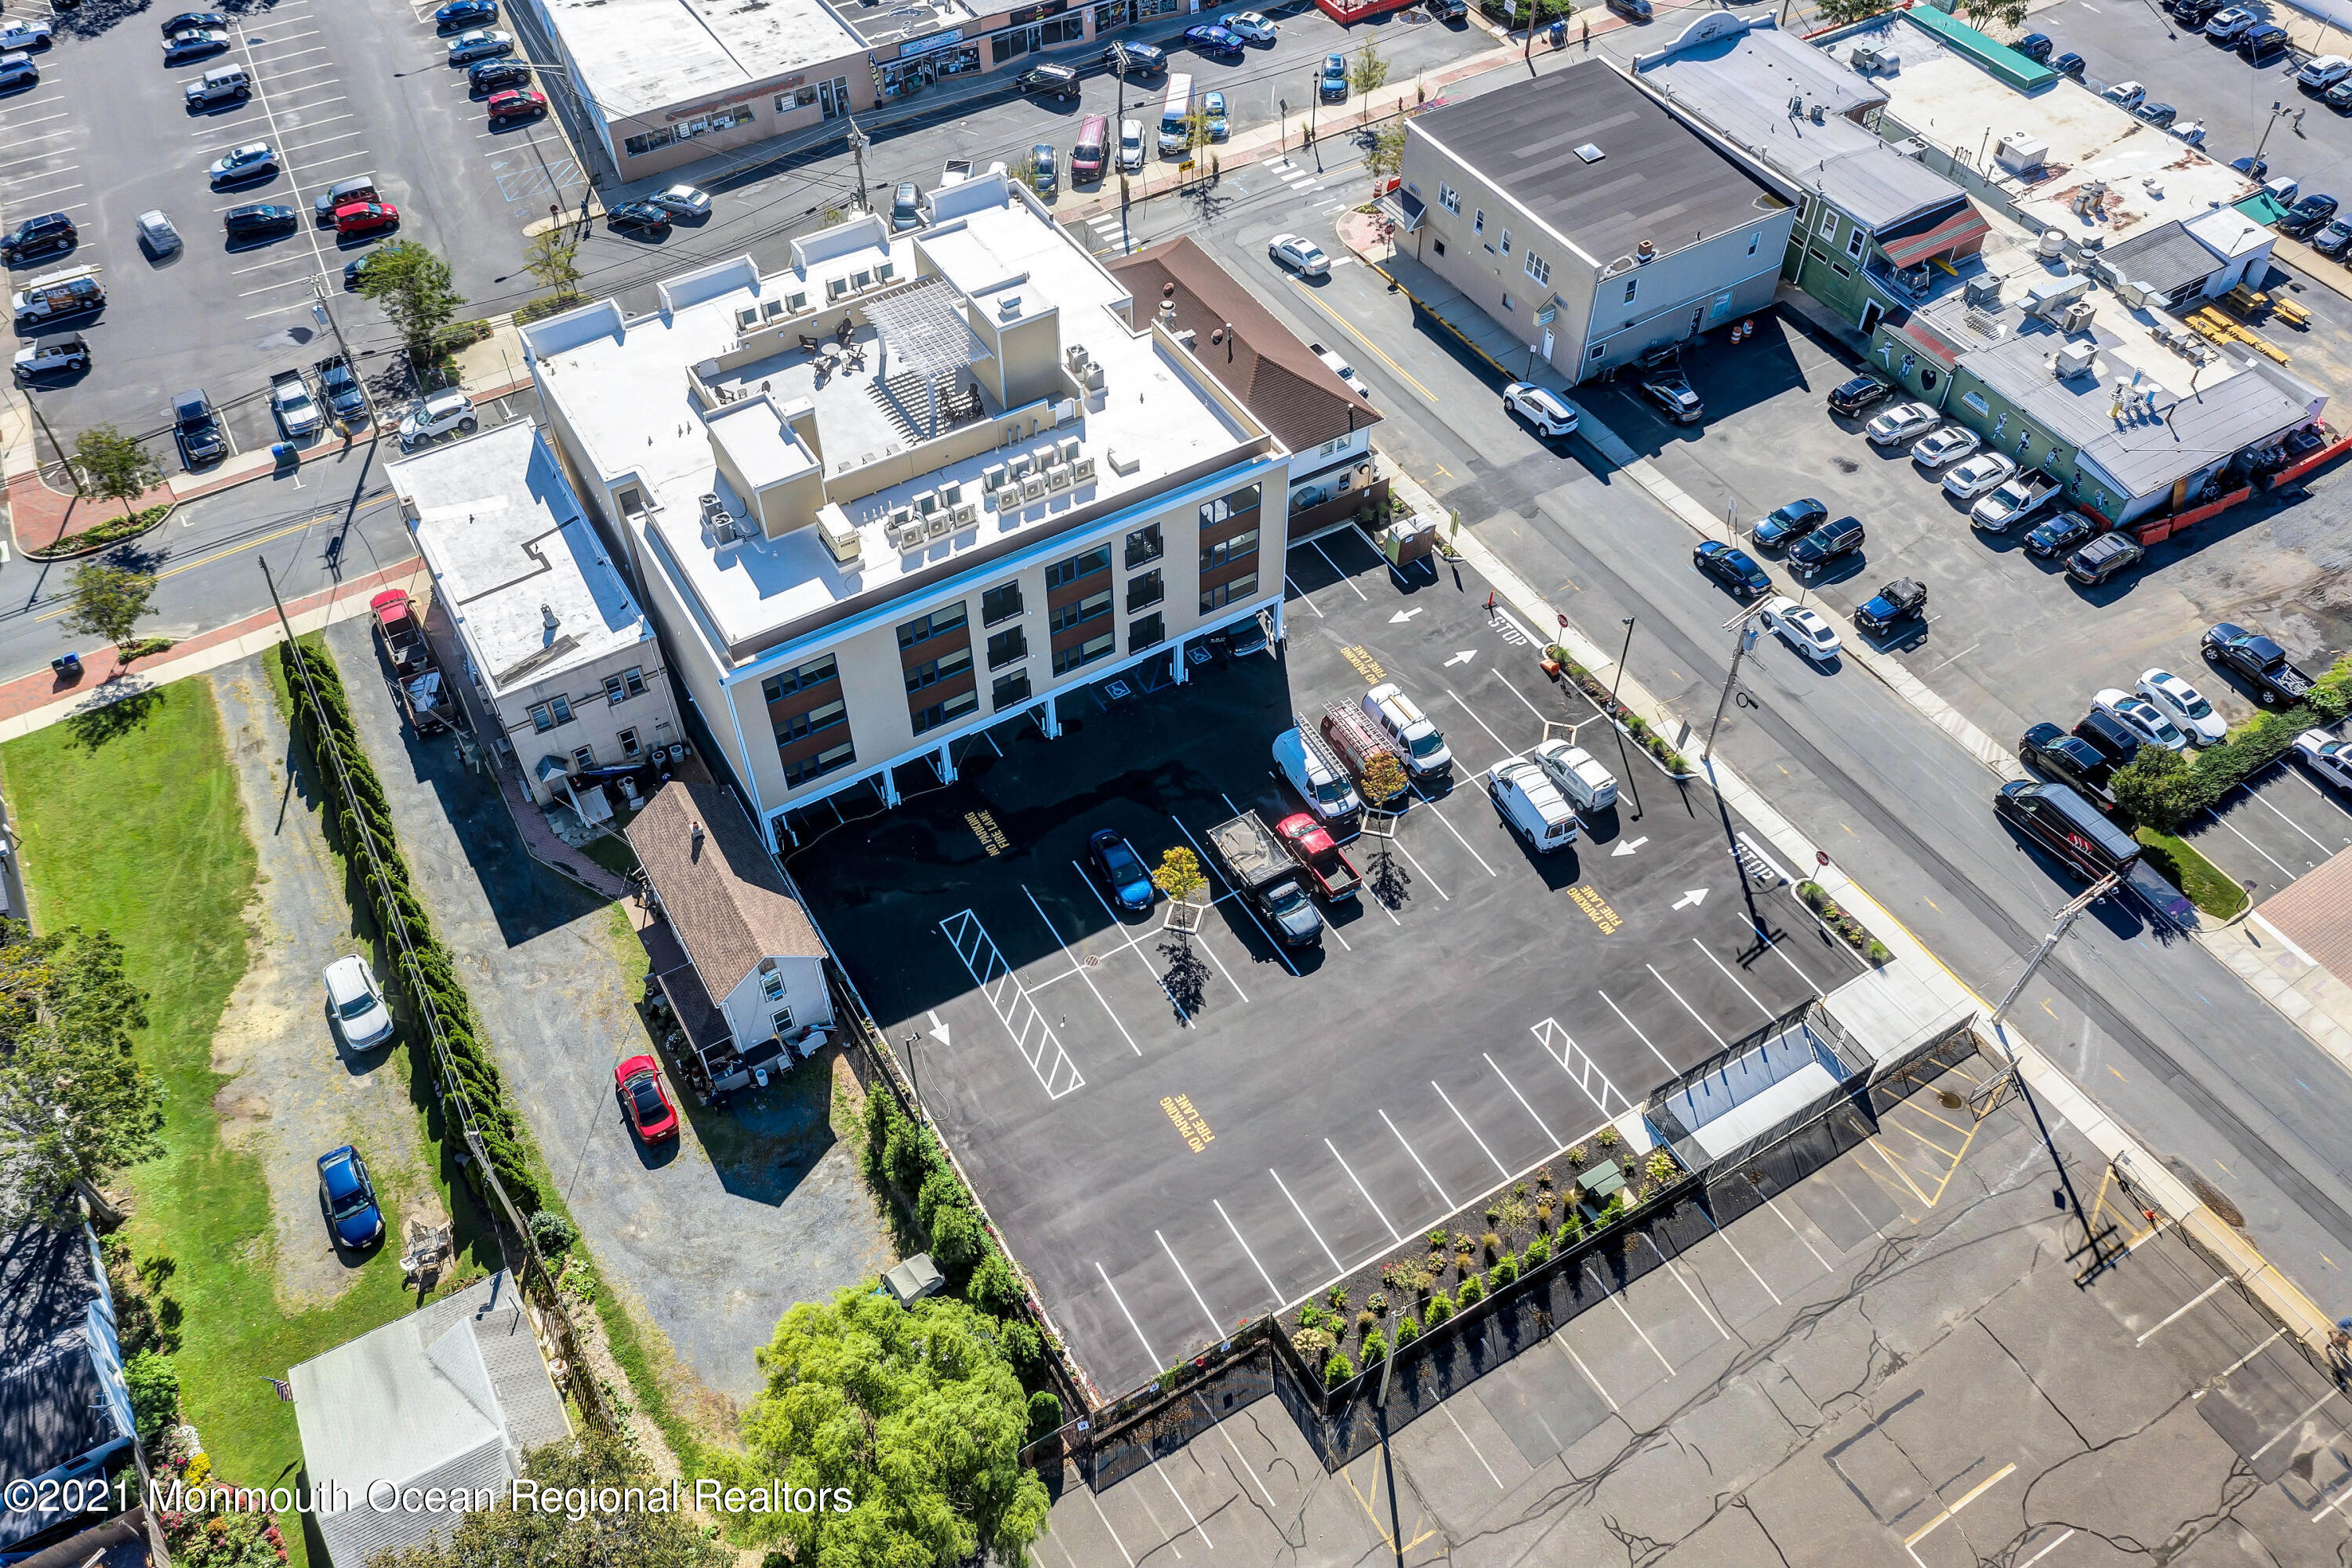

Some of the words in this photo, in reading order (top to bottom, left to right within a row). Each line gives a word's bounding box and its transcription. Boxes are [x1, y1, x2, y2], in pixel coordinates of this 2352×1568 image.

[47, 288, 71, 297] DECK
[1488, 616, 1528, 645] STOP
[1340, 646, 1370, 675] PARKING
[1352, 644, 1374, 663] LANE
[1365, 673, 1380, 685] NO
[1367, 662, 1388, 678] FIRE
[964, 811, 992, 845] PARKING
[978, 809, 998, 831] LANE
[991, 829, 1010, 849] FIRE
[985, 844, 1000, 857] NO
[1817, 853, 1828, 863] STOP
[1727, 843, 1775, 880] STOP
[1566, 887, 1604, 923] PARKING
[1580, 884, 1606, 908] LANE
[1599, 906, 1624, 927] FIRE
[1598, 921, 1616, 935] NO
[1160, 1096, 1195, 1138] PARKING
[1174, 1093, 1200, 1121] LANE
[1192, 1118, 1216, 1143] FIRE
[1188, 1136, 1206, 1154] NO
